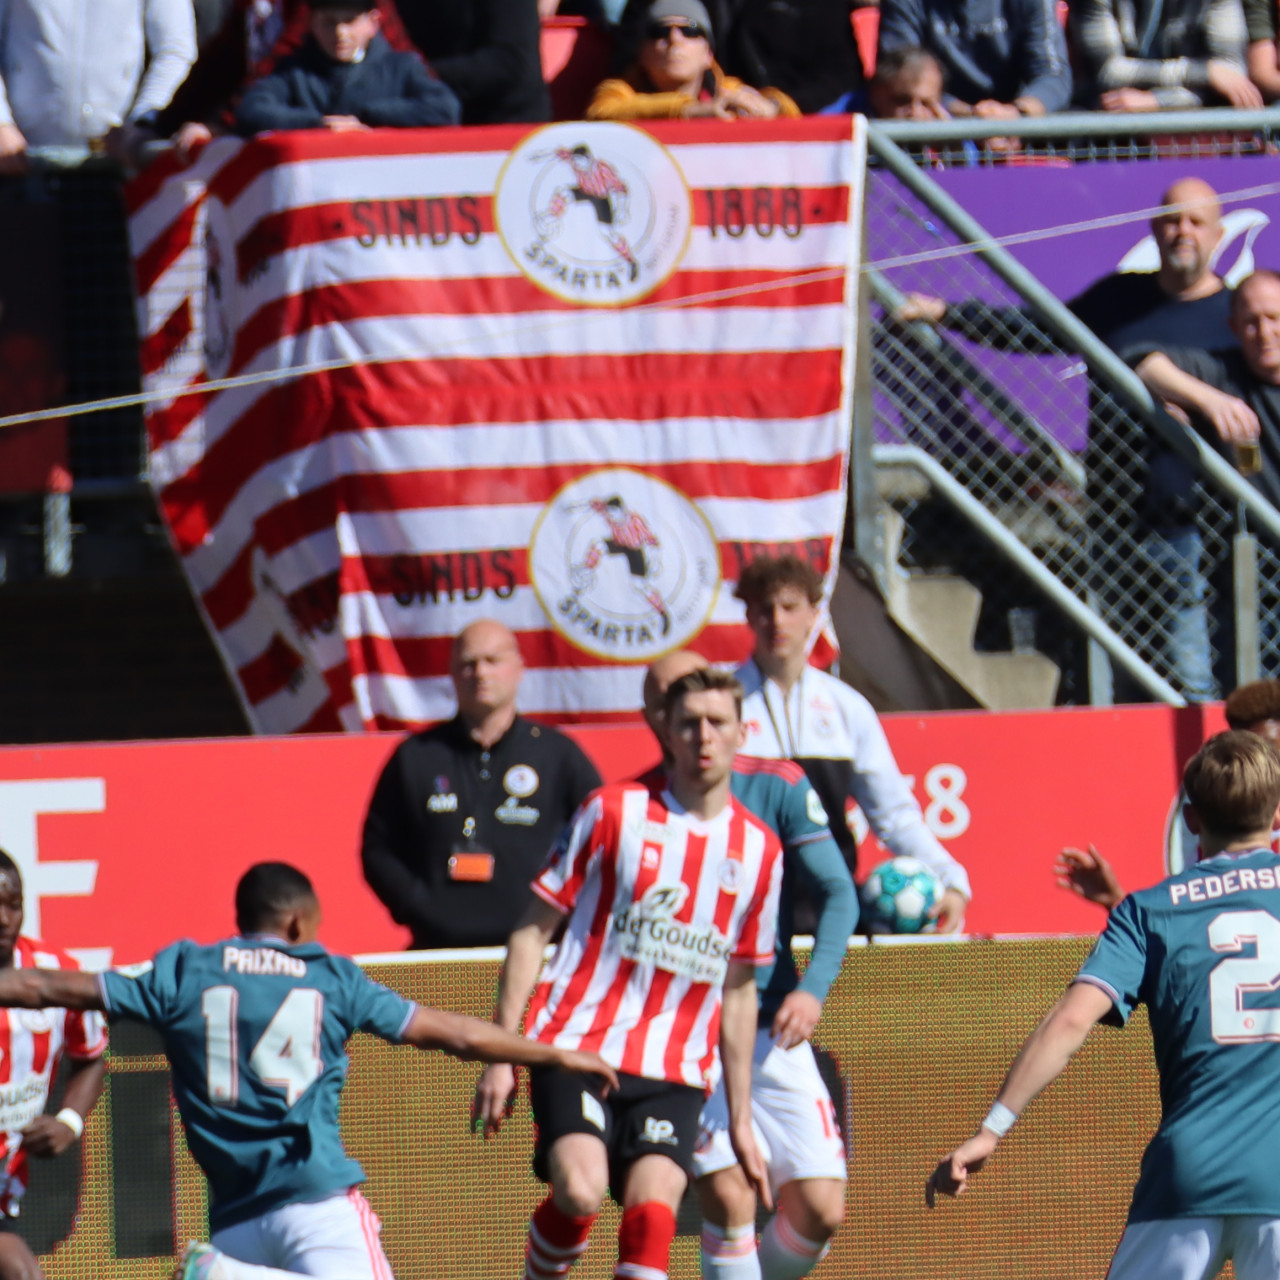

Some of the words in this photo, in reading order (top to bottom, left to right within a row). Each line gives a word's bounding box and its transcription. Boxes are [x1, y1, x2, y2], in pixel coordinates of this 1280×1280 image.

[352, 195, 481, 248] SINDS
[705, 187, 803, 238] 1888
[524, 240, 622, 290] SPARTA
[392, 549, 517, 607] SINDS
[558, 597, 656, 645] SPARTA
[1207, 909, 1280, 1044] 2
[201, 984, 324, 1109] 14
